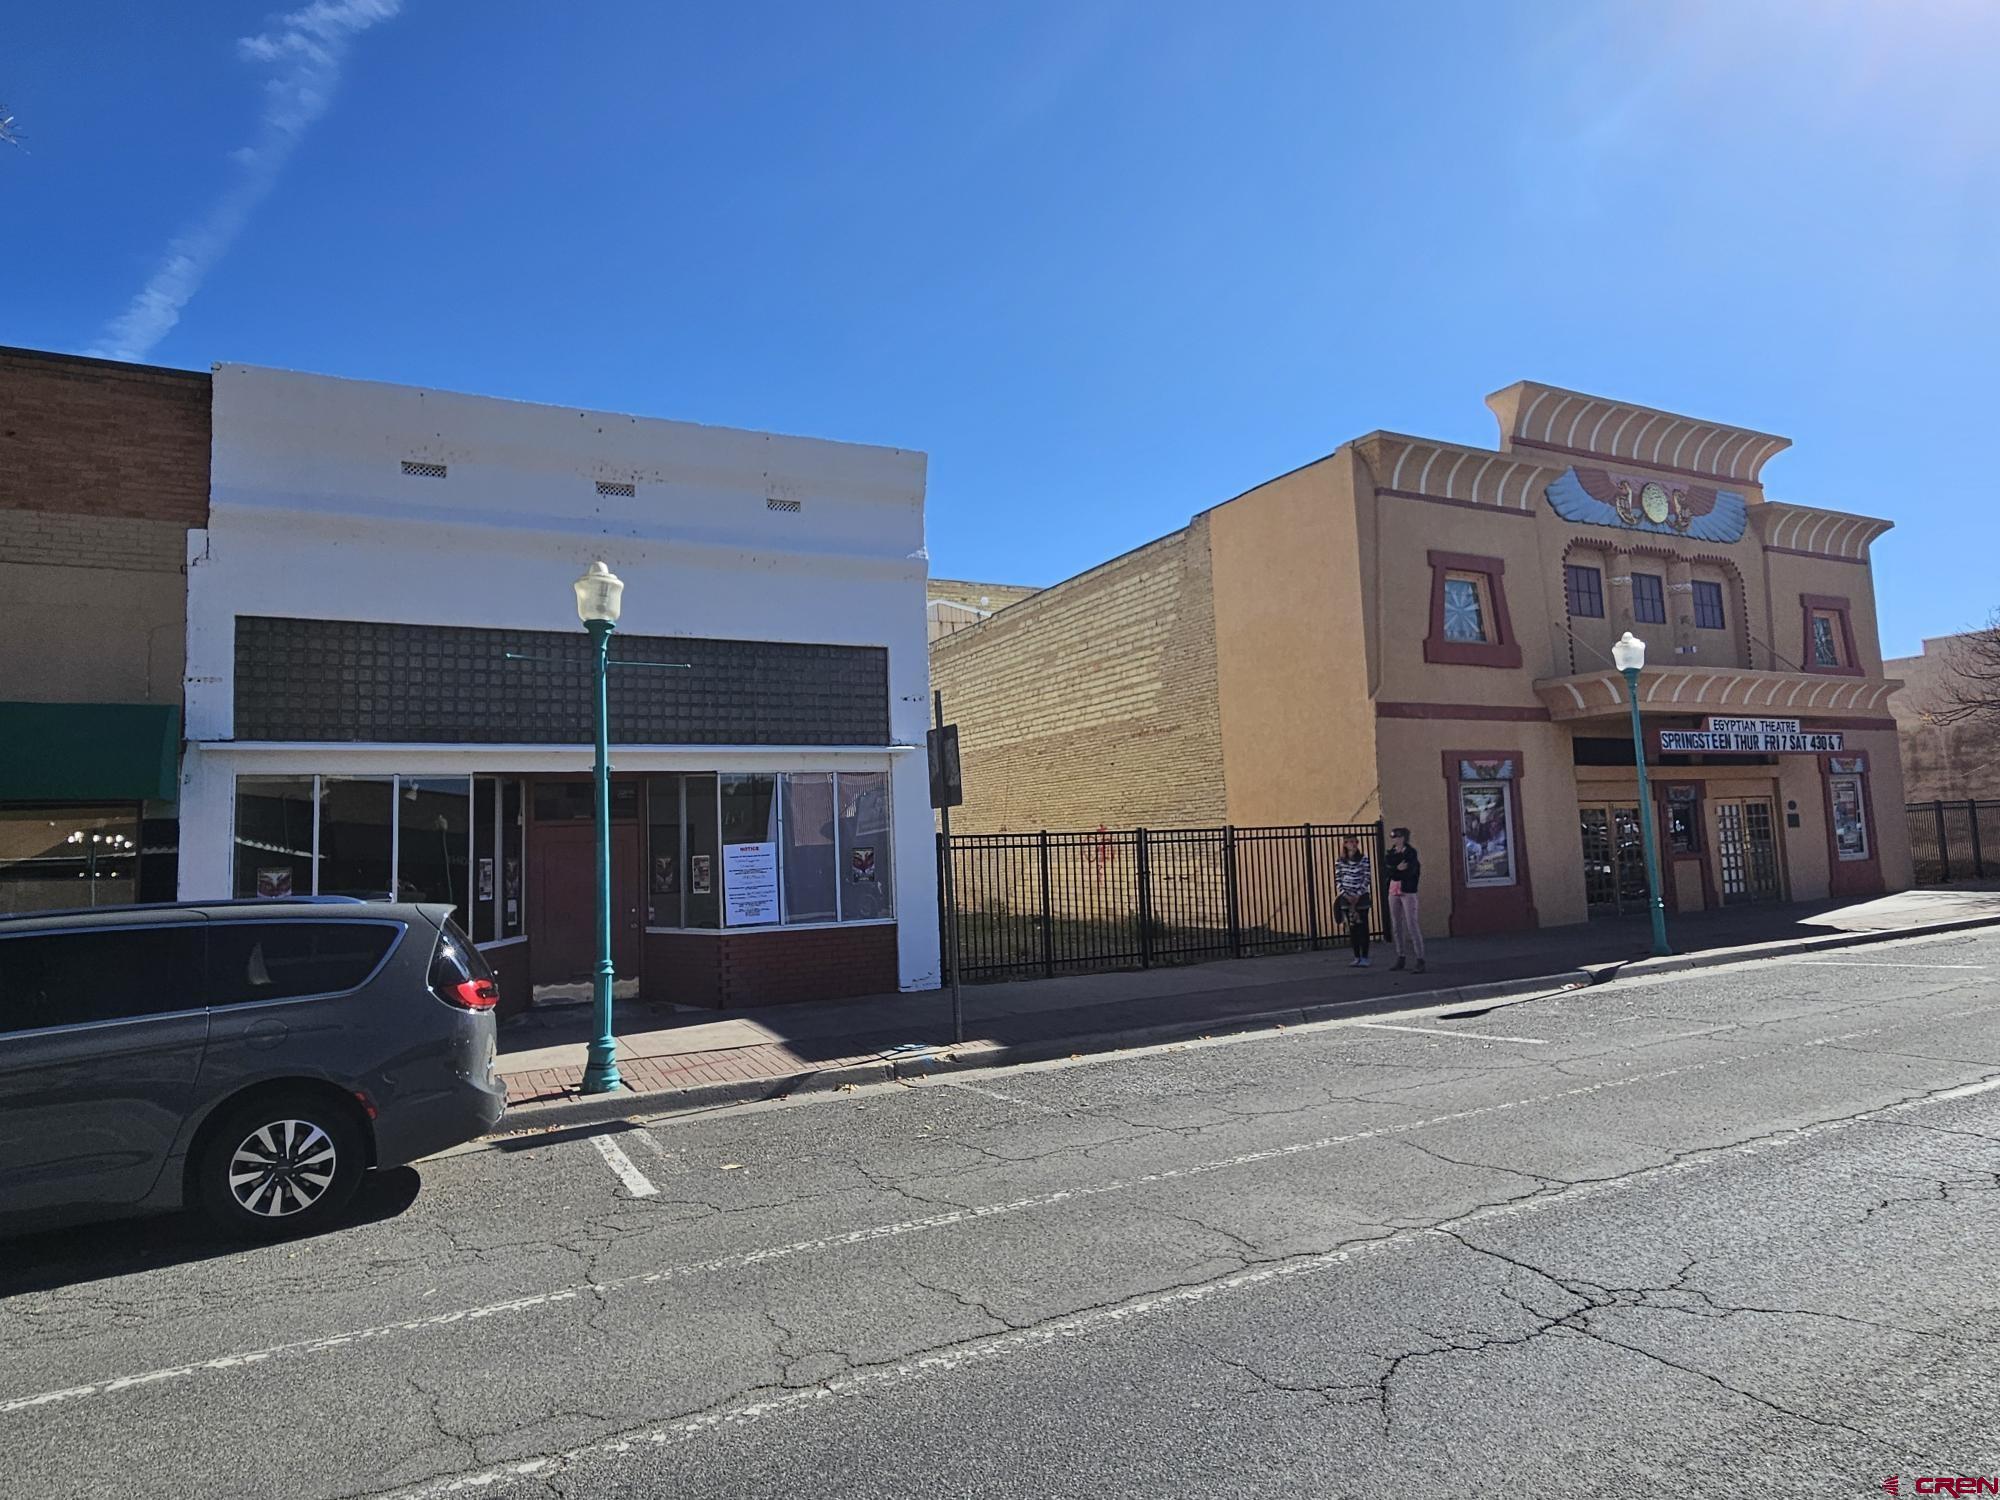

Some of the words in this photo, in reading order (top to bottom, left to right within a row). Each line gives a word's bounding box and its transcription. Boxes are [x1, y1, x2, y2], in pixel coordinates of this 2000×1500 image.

[1713, 719, 1756, 731] EGYPTIAN
[1761, 721, 1796, 733] THEATRE
[1662, 733, 1731, 749] SPRINGSTEEN
[1735, 734, 1759, 750] THUR
[1764, 735, 1779, 750] FRI
[1790, 735, 1807, 750] SAT
[1810, 735, 1827, 750] 430
